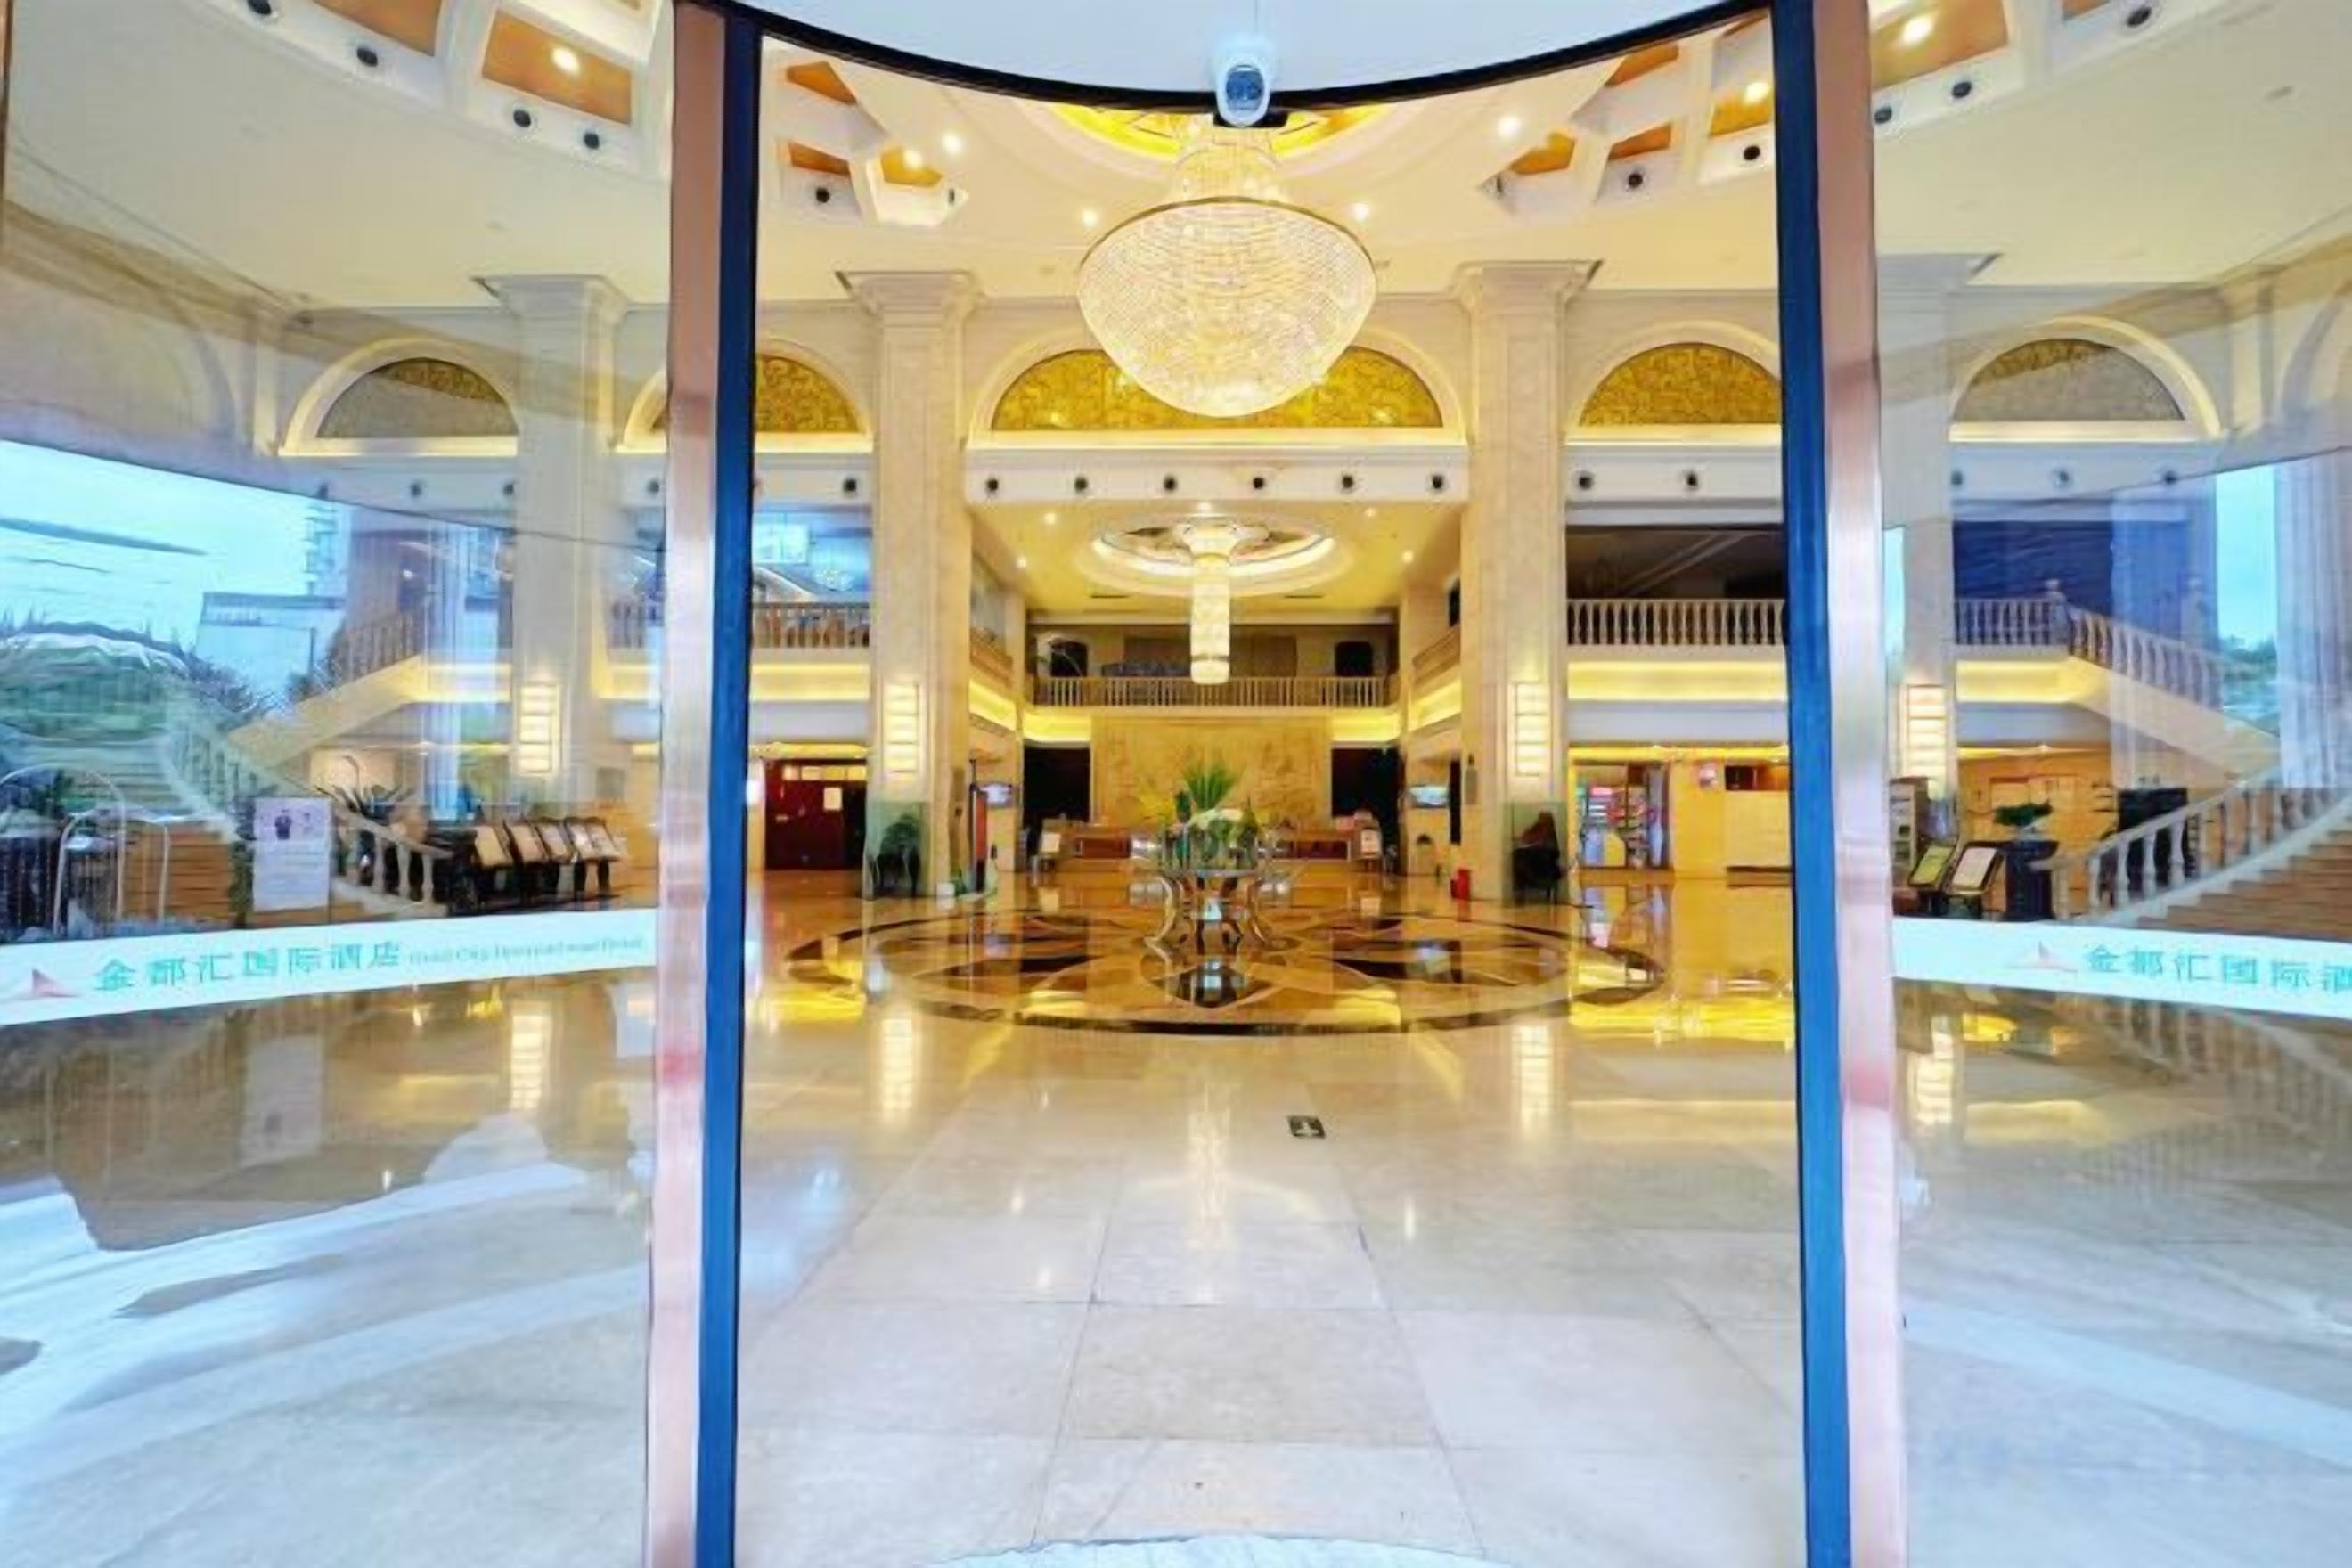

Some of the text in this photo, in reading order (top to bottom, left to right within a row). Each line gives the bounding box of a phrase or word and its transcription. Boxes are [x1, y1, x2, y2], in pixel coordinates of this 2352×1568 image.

[94, 941, 401, 990] 金都汇国际酒店
